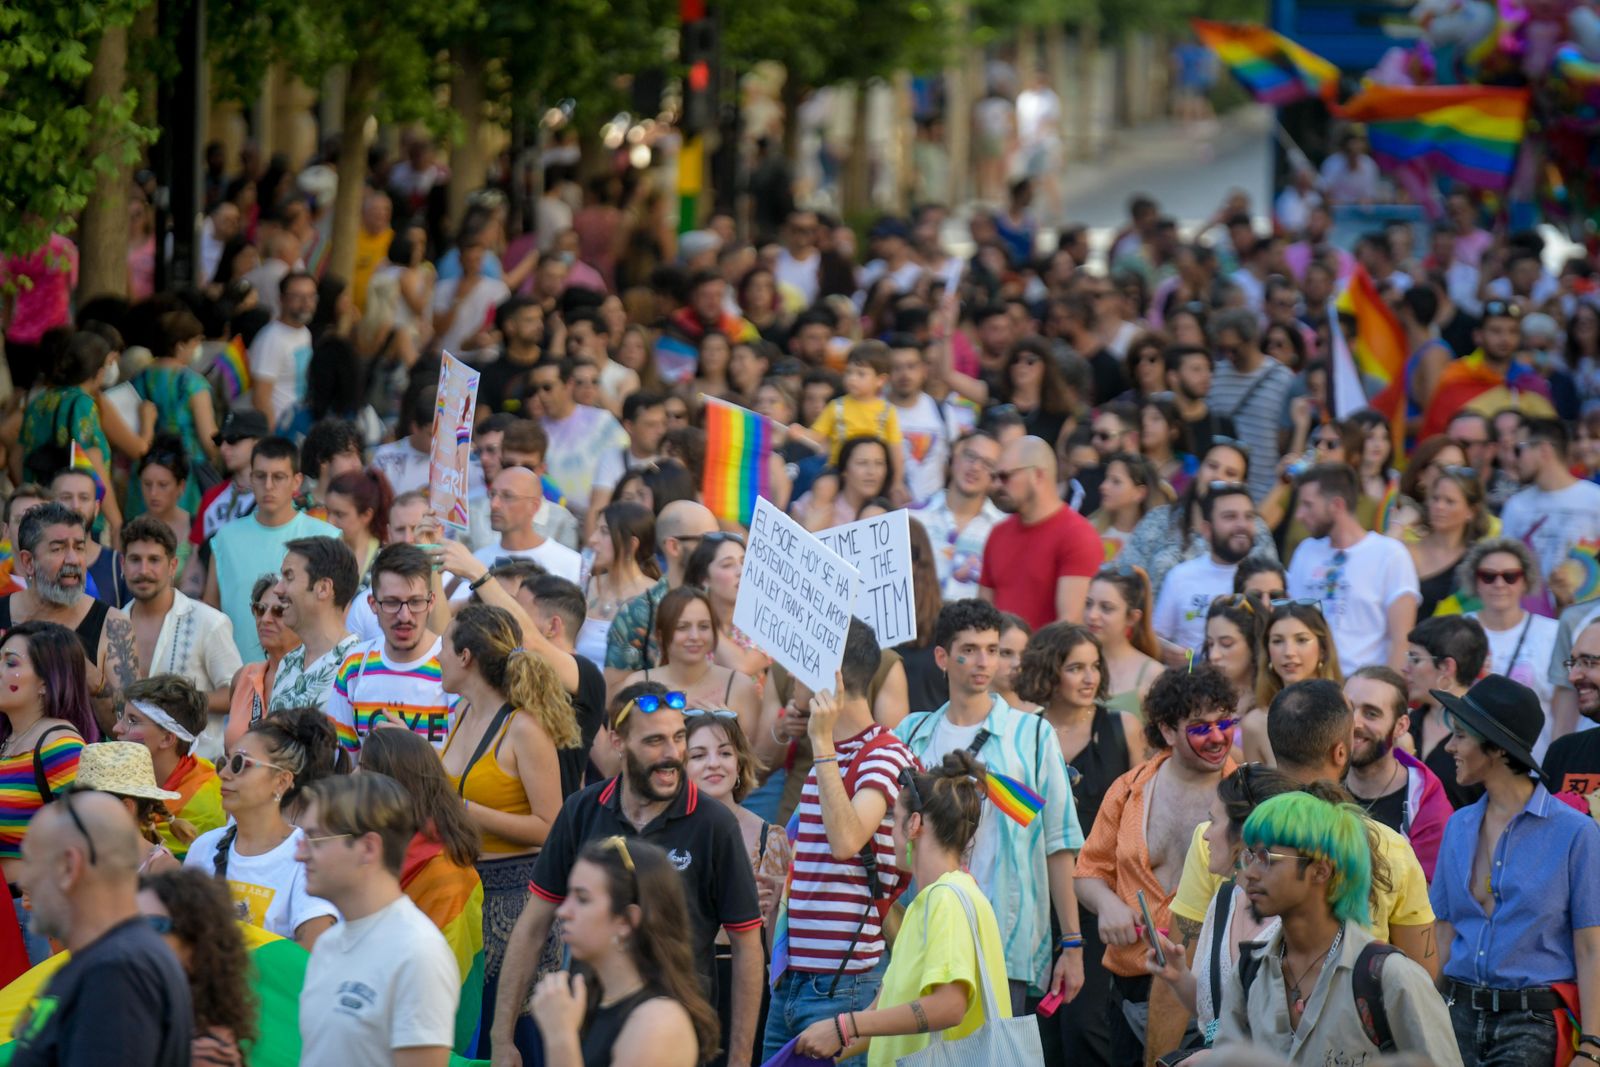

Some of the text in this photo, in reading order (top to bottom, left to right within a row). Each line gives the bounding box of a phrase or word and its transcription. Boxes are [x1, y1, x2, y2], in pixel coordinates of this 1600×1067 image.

[756, 509, 768, 538] EL
[772, 523, 798, 558] PSOE
[801, 547, 821, 574] HOY
[821, 561, 836, 587] SE
[836, 574, 849, 601] HA
[869, 520, 890, 550] TO
[870, 549, 897, 579] THE
[746, 560, 841, 655] A LA LEY TRANS Y LGTBI
[750, 537, 849, 631] ABSTENIDO EN EL APOYO
[754, 597, 820, 677] VERGÜENZA
